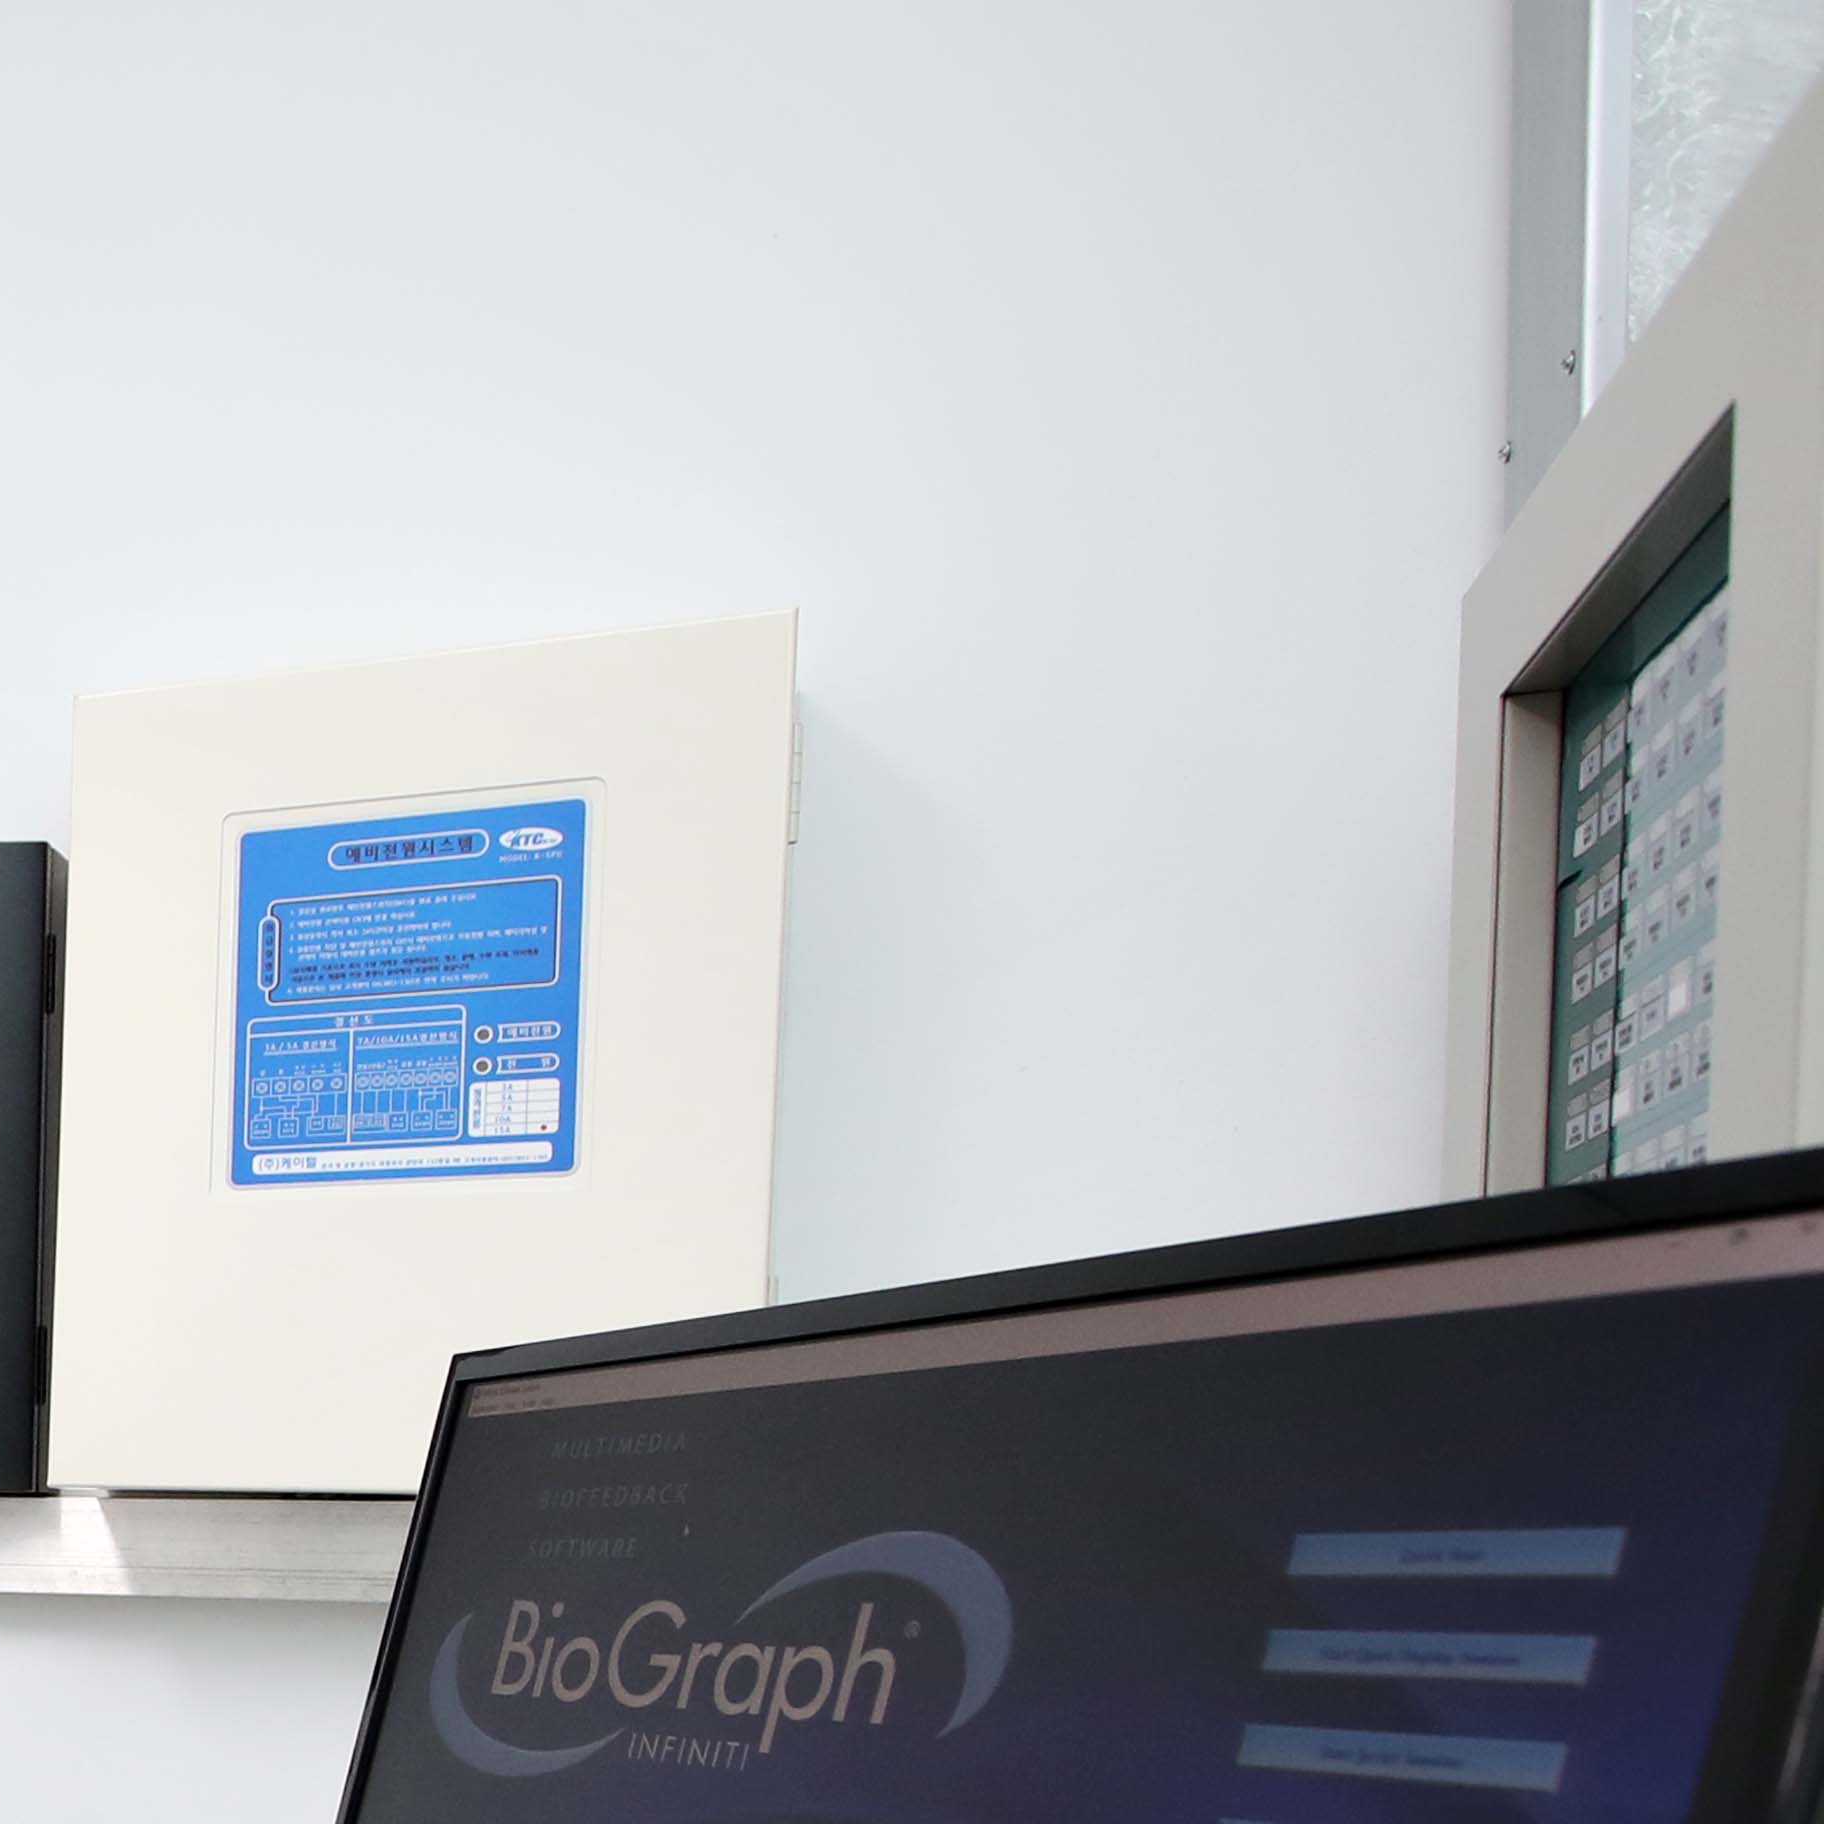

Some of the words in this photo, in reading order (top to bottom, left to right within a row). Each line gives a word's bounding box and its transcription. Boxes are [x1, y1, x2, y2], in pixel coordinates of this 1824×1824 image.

[345, 834, 473, 863] 예비전원시스템
[551, 1432, 687, 1460] MULTIMEDIA
[540, 1483, 688, 1510] BIOFEEDBACK
[528, 1537, 640, 1561] SOFTWARE
[489, 1598, 895, 1754] BioGraph
[628, 1731, 751, 1771] INFINITI
